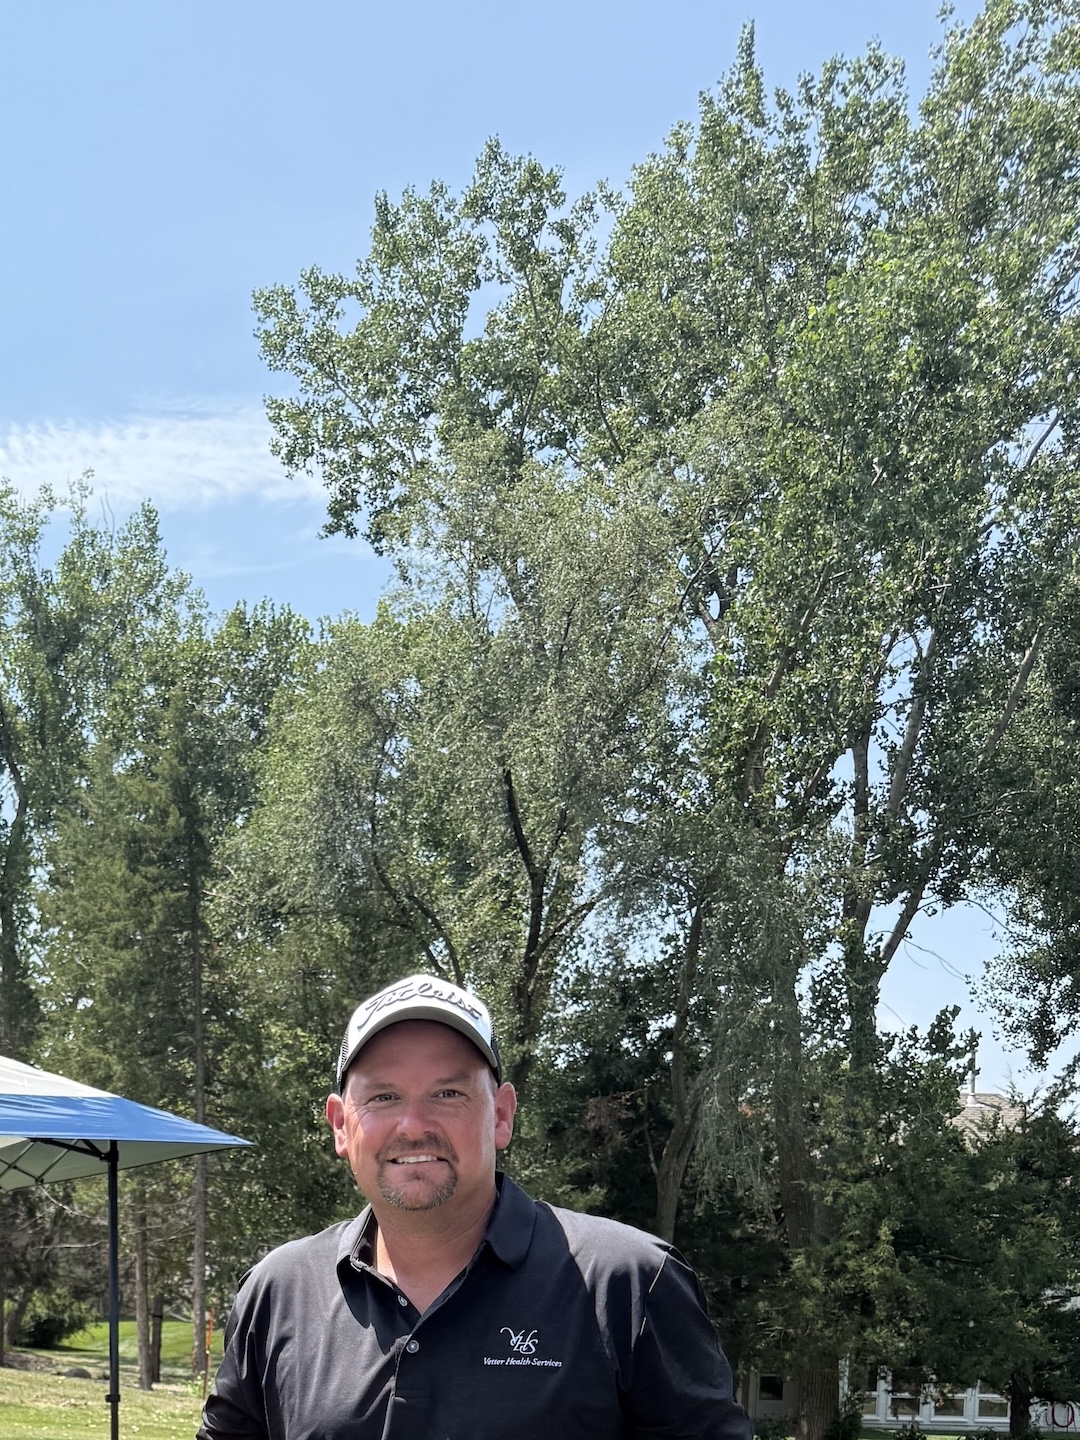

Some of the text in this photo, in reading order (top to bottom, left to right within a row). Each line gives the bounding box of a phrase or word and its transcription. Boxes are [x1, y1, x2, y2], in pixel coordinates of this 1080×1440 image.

[357, 982, 483, 1030] Titleist
[500, 1327, 539, 1355] VHS
[483, 1357, 563, 1367] Vetter Health Services
